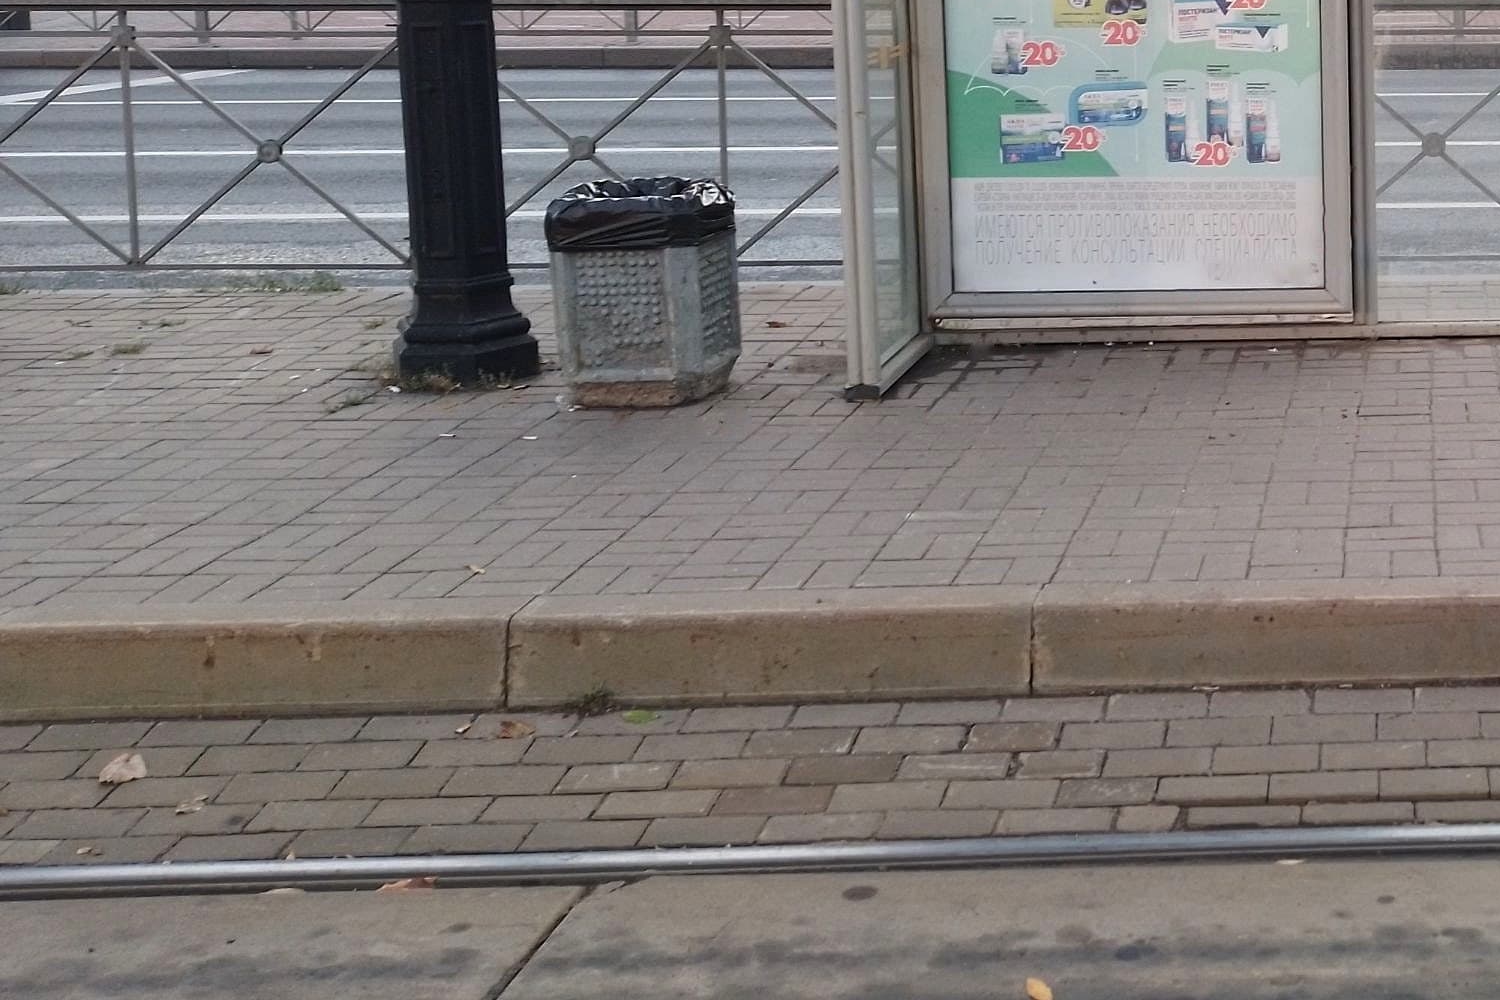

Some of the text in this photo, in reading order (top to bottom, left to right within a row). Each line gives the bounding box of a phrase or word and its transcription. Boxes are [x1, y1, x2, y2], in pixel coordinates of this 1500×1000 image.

[975, 214, 1043, 239] ИМЕЮТСЯ
[1203, 212, 1297, 238] НЕОБХОДИМО
[975, 238, 1297, 264] ПОЛУЧЕНИЕ КОНСУЛЬТАЦИИ СПЕЦИАЛИСТА
